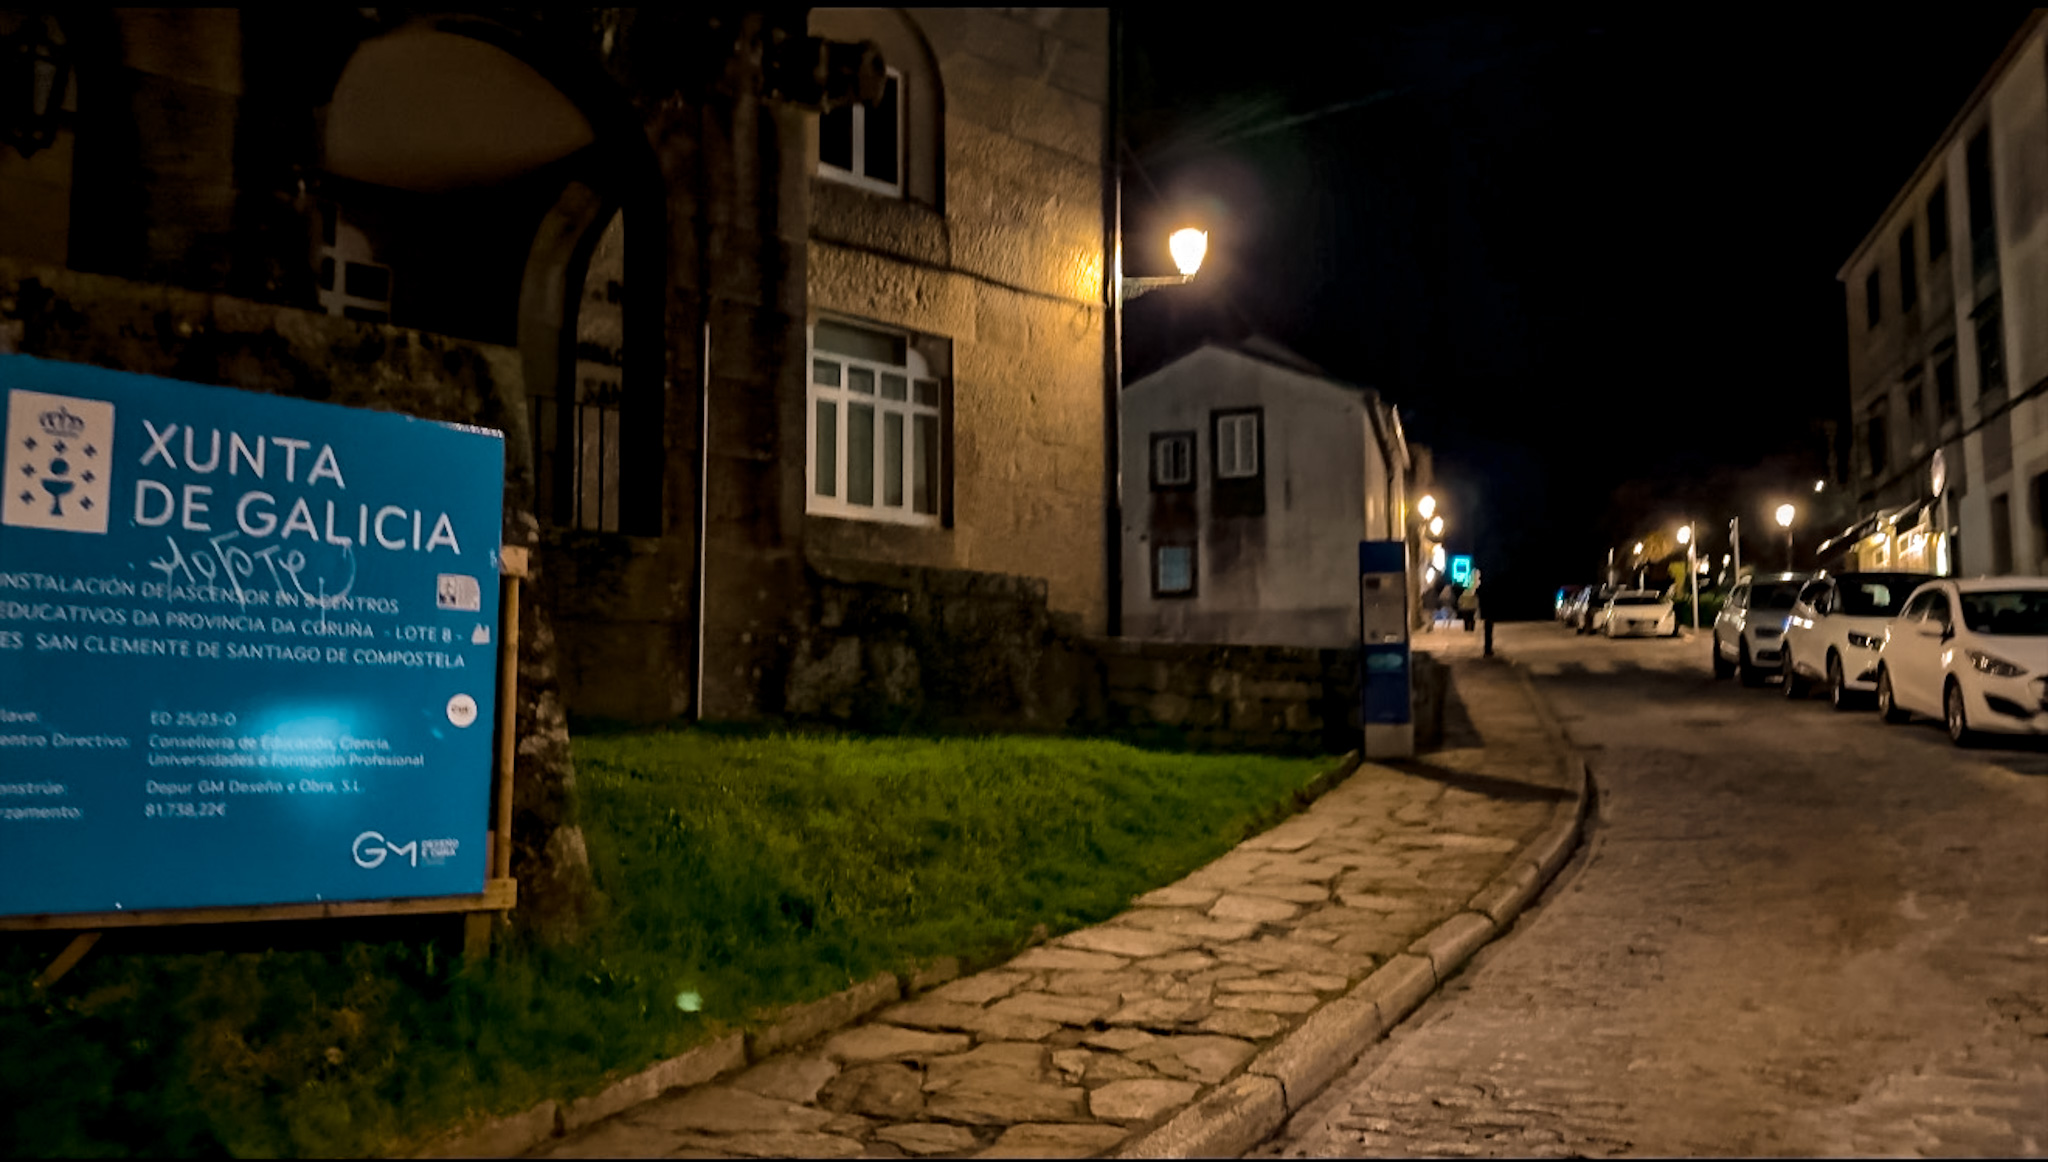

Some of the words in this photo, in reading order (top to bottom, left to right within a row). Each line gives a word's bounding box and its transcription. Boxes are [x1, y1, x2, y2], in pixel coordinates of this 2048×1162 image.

[140, 419, 345, 489] XUNTA
[135, 479, 212, 531] DE
[236, 491, 460, 555] GALICIA
[141, 582, 166, 599] DE
[132, 609, 160, 627] DA
[166, 611, 266, 632] PROVINCIA
[272, 617, 296, 634] DA
[302, 618, 374, 638] CORUÑA
[395, 625, 437, 642] LOTE
[36, 633, 78, 651] SAN
[84, 635, 191, 658] CLEMENTE
[197, 641, 220, 659] DE
[226, 642, 321, 662] SANTIAGO
[326, 647, 348, 664] DE
[353, 648, 465, 669] COMPOSTELA
[352, 830, 417, 869] GM
